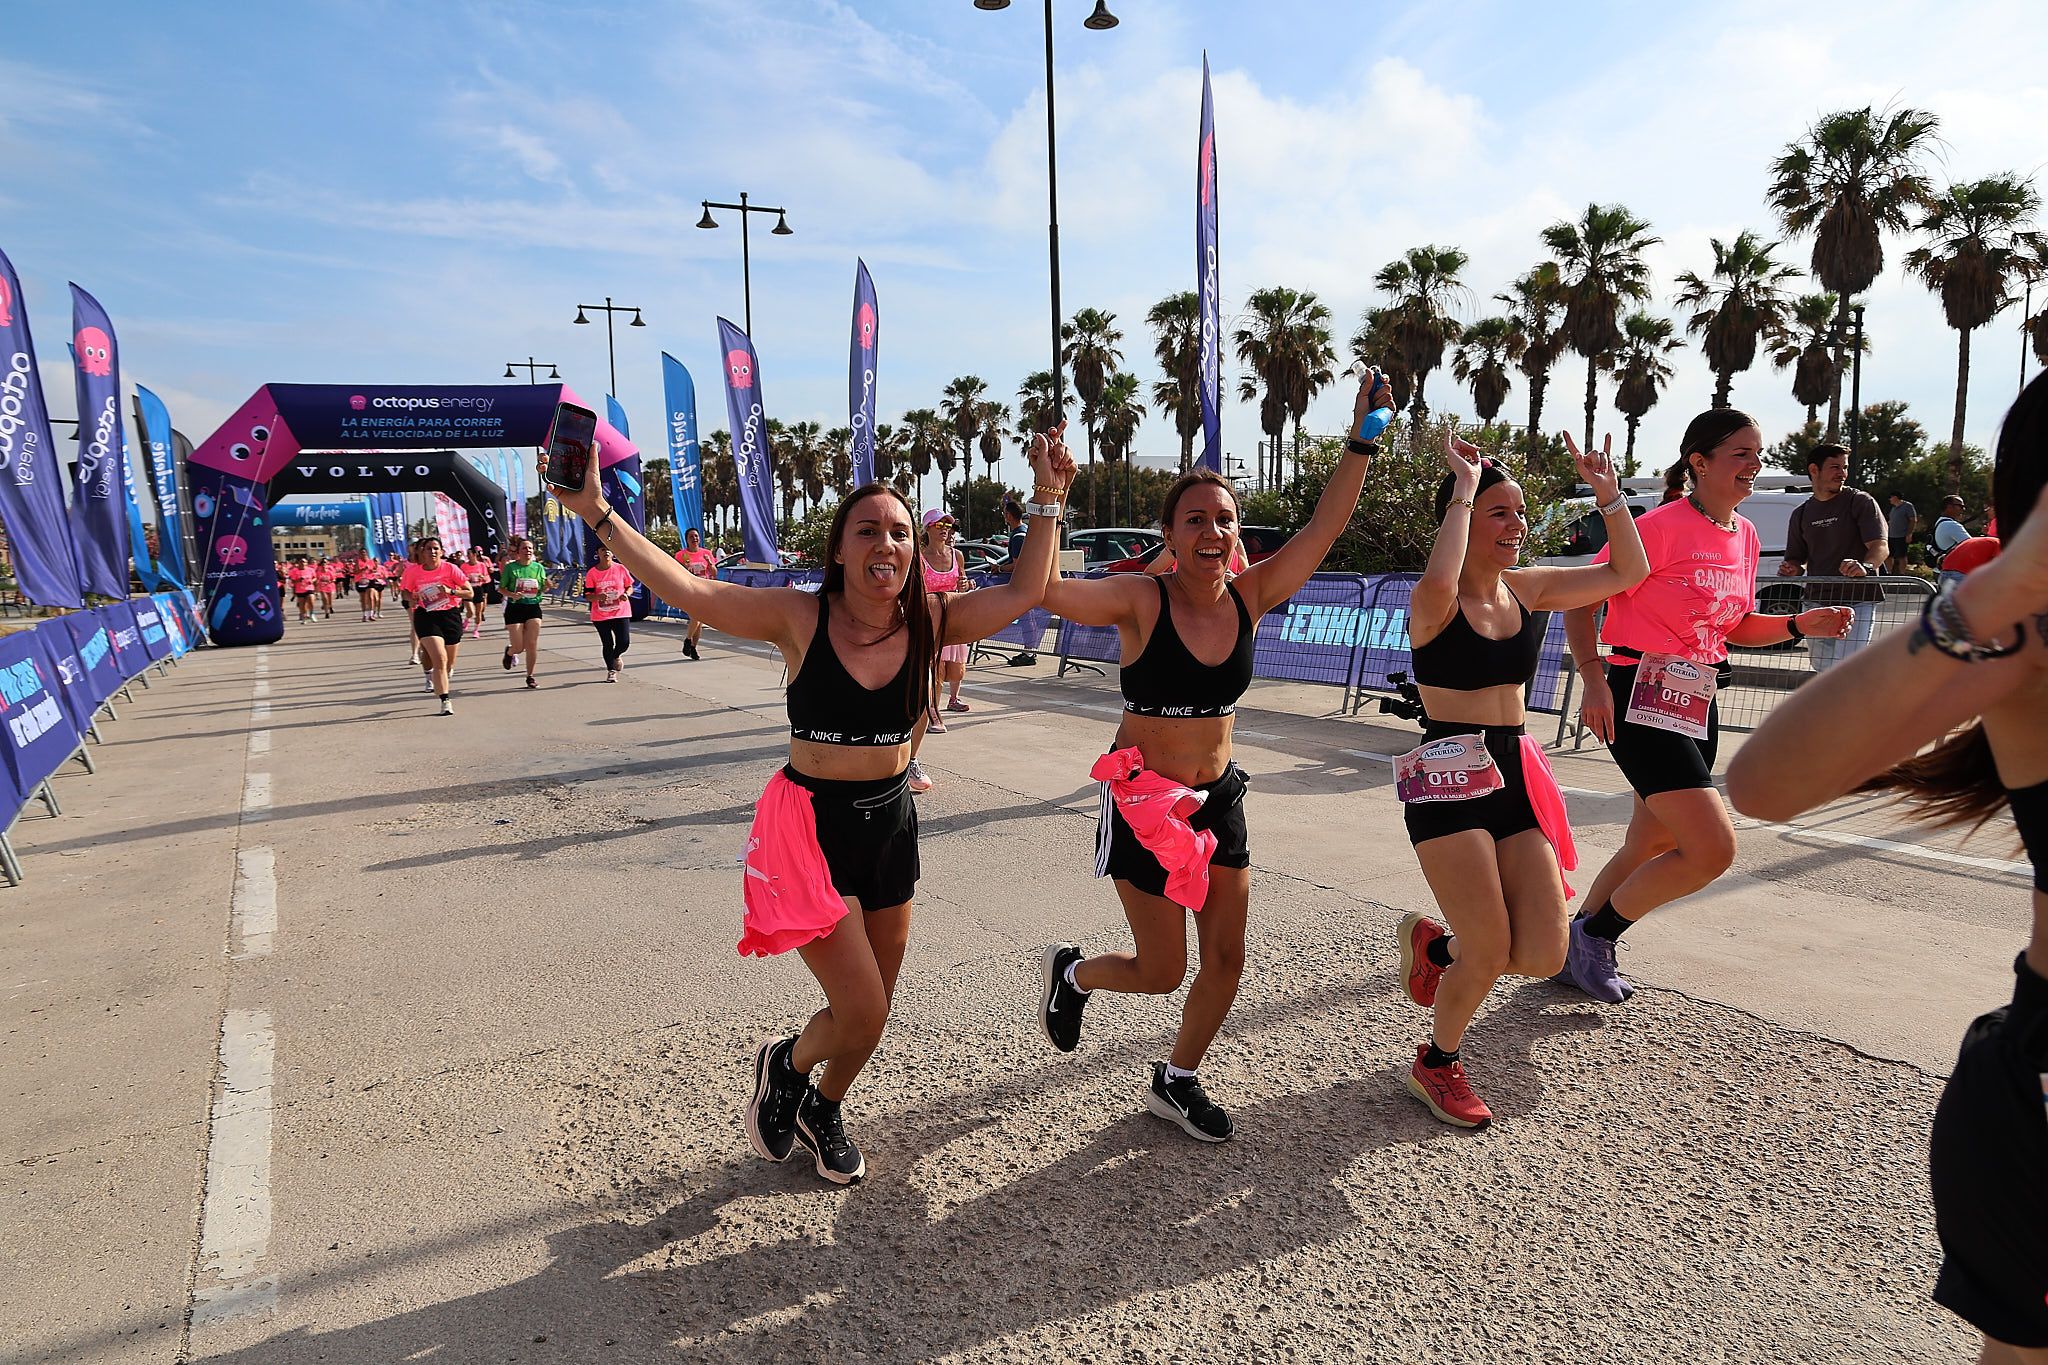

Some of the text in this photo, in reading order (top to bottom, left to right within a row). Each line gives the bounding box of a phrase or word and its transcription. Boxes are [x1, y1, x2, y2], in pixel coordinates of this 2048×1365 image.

[341, 415, 502, 427] LA ENERGÍA PARA CORRER
[340, 429, 505, 438] A LA VELOCIDAD DE LA LUZ
[296, 465, 430, 477] VOLVO
[1691, 552, 1722, 561] OYSHO
[1661, 688, 1691, 707] 016
[1160, 706, 1194, 716] NIKE
[1219, 703, 1236, 715] NIKE
[1636, 713, 1664, 725] OYSHO
[810, 730, 901, 744] NIKE NIKE
[1428, 771, 1469, 786] 016
[1442, 786, 1461, 794] 1158
